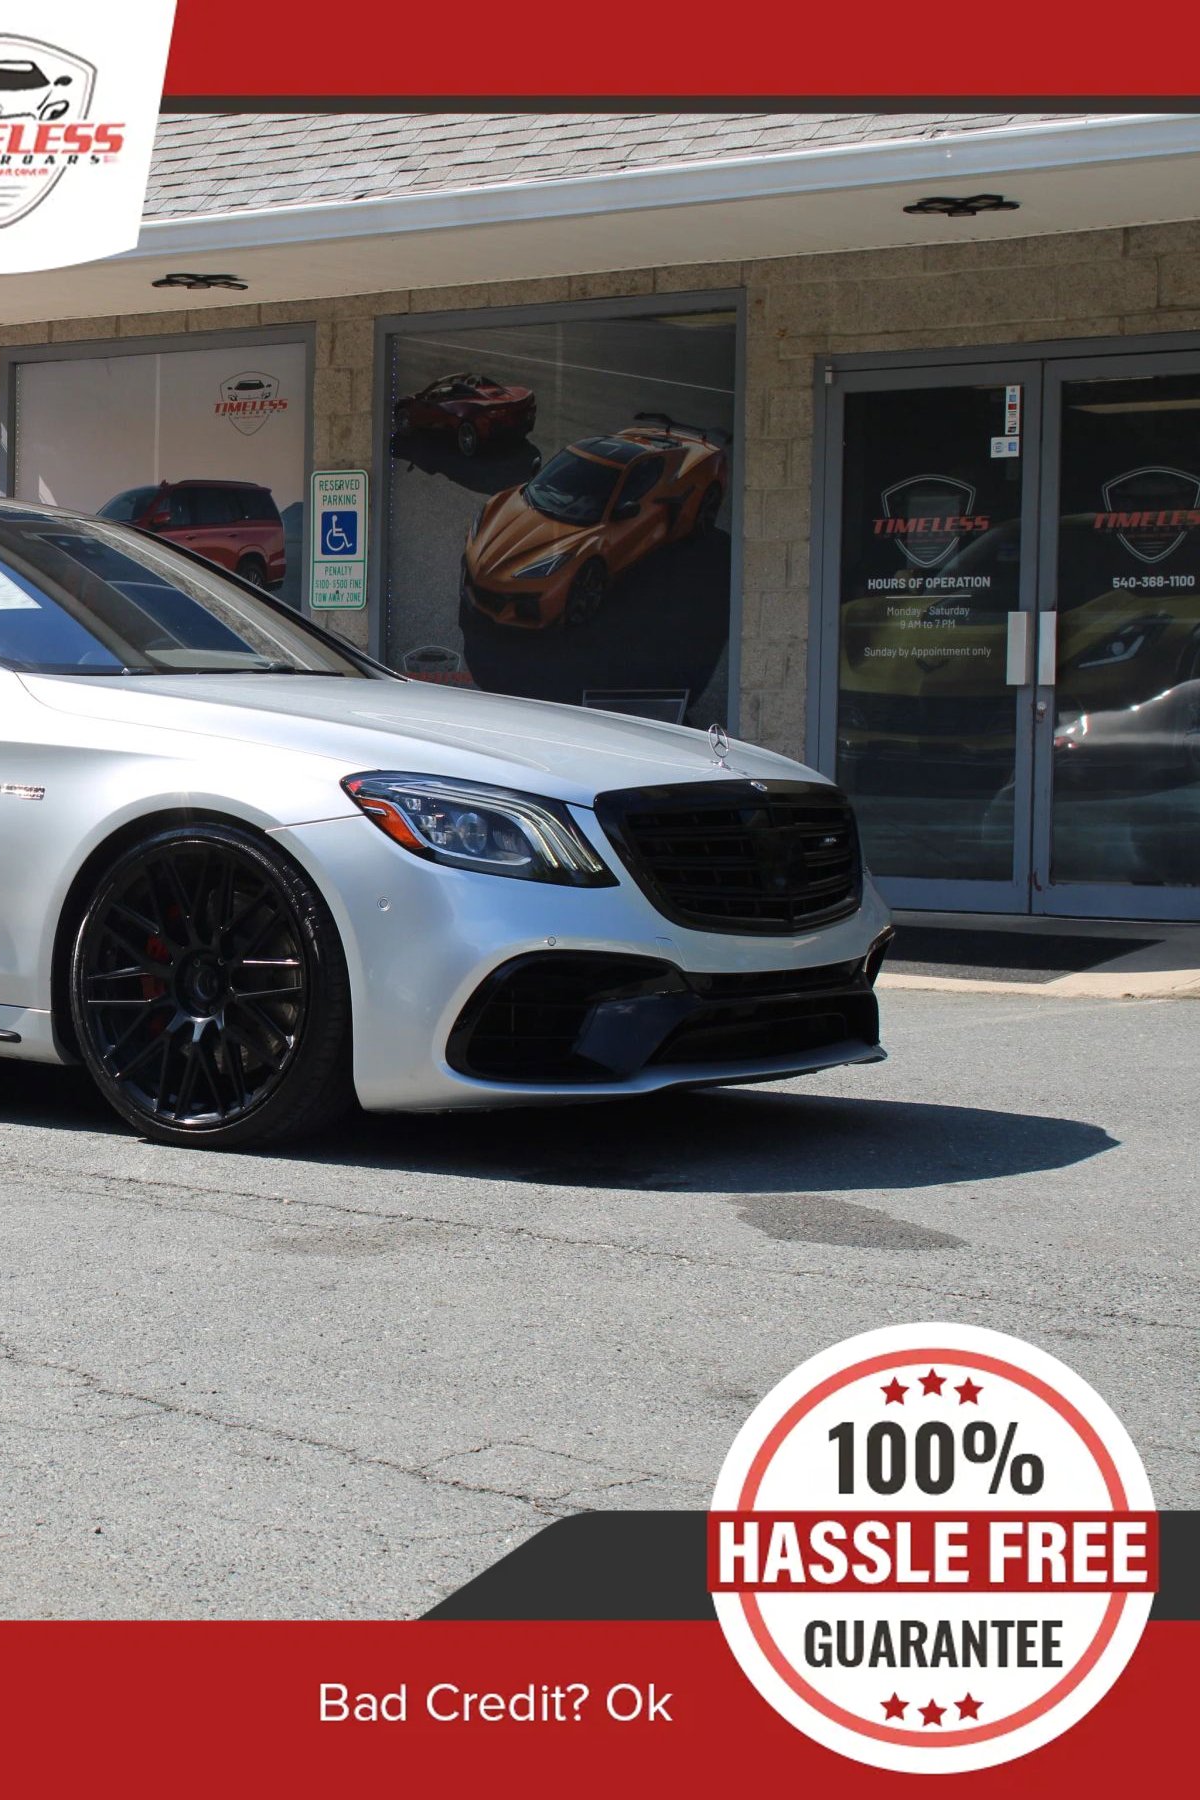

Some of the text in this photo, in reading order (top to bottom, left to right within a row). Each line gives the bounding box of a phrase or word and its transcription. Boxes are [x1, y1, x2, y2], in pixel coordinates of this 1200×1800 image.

[214, 399, 288, 414] TIMELESS
[319, 479, 360, 491] RESERVED
[322, 494, 357, 506] PARKING
[872, 515, 991, 534] TIMELESS
[325, 566, 352, 576] PENALTY
[349, 579, 362, 589] FINE
[868, 576, 991, 590] HOURS OF OPERATION
[1112, 575, 1195, 588] 540-368-1100
[315, 592, 362, 602] TOW AWAY ZONE
[886, 606, 921, 617] Monday
[928, 605, 970, 617] Saturday
[908, 620, 921, 629] AM
[923, 620, 933, 629] to
[941, 619, 956, 628] PM
[864, 645, 992, 658] Sunday by Appointment only
